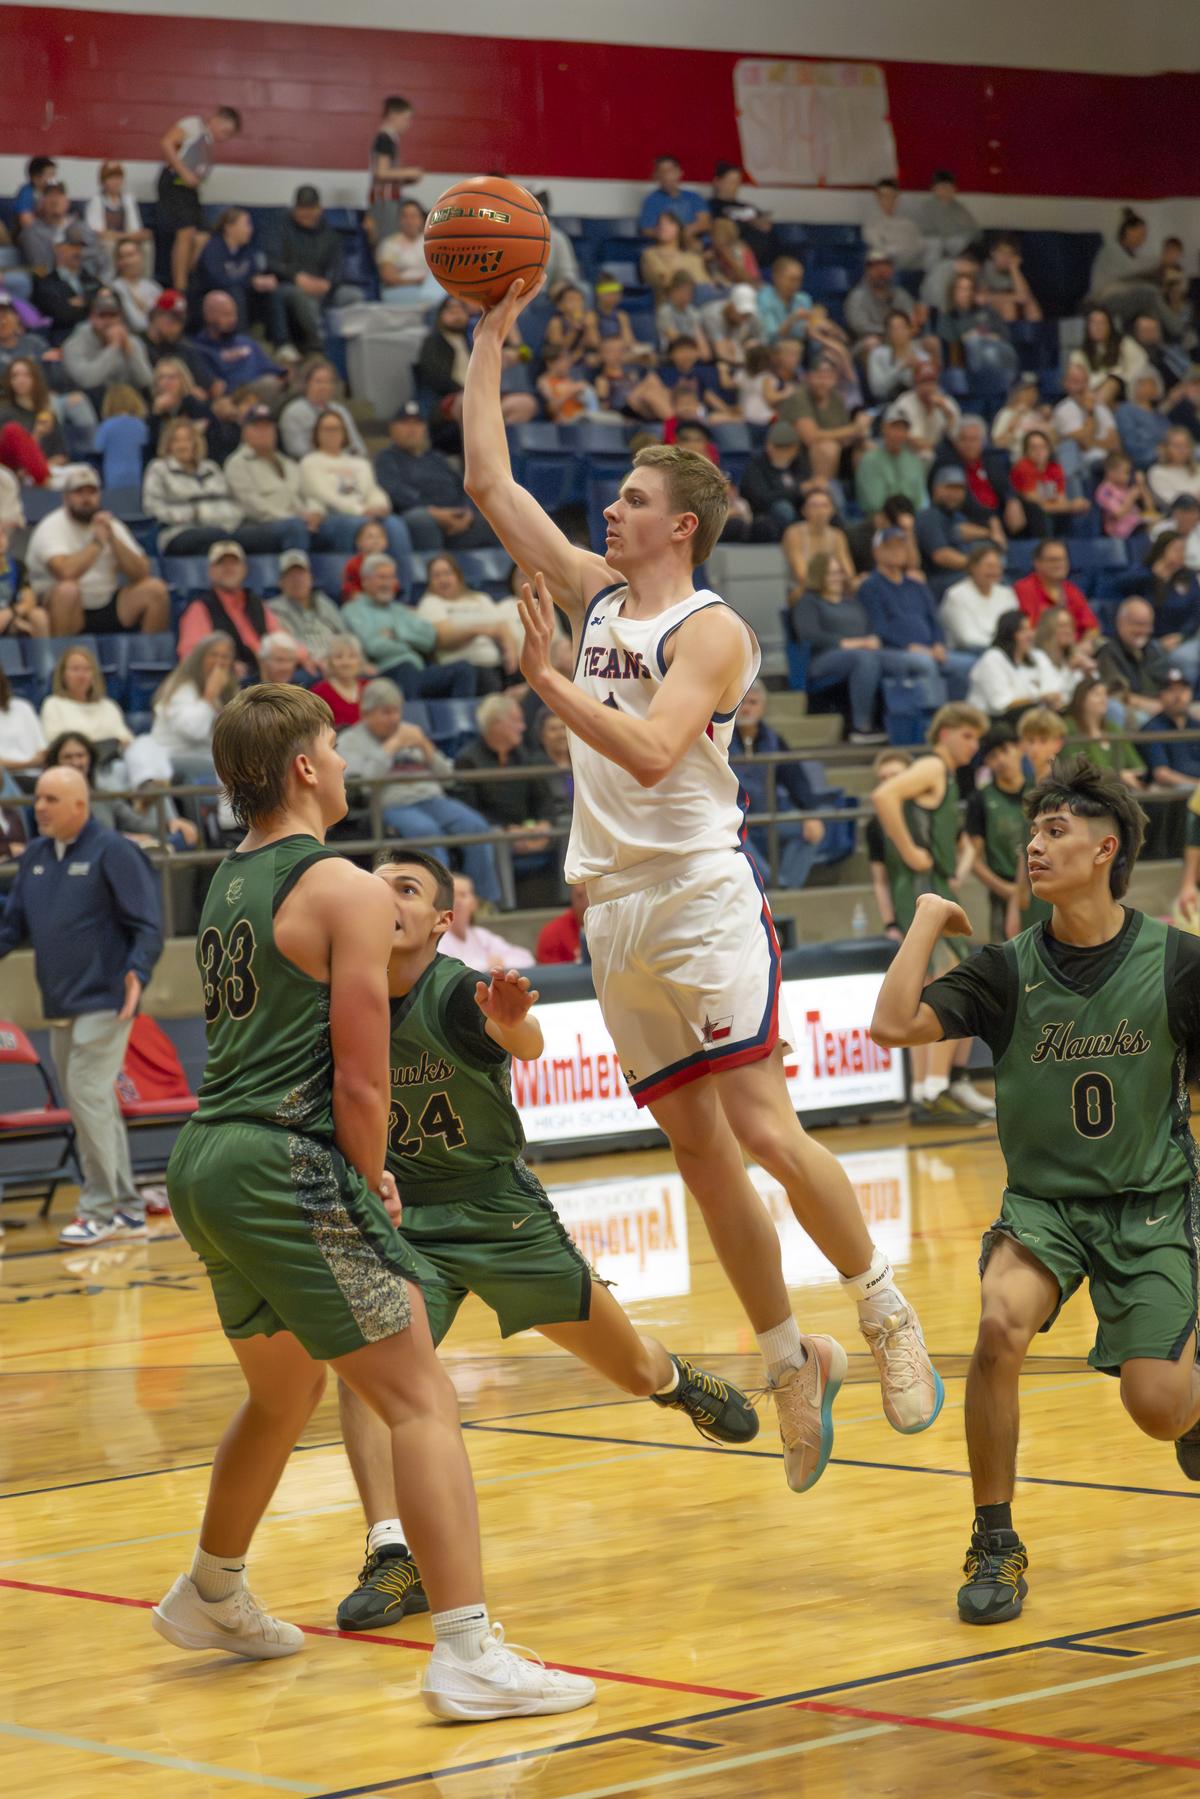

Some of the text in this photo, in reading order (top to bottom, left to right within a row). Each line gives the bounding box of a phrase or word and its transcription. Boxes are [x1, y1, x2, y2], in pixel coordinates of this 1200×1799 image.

[583, 646, 652, 680] TEANS
[200, 919, 260, 1024] 33
[511, 1032, 631, 1108] Wimber
[1031, 1019, 1151, 1063] Hawks
[388, 1091, 467, 1157] 24
[1070, 1071, 1117, 1140] 0
